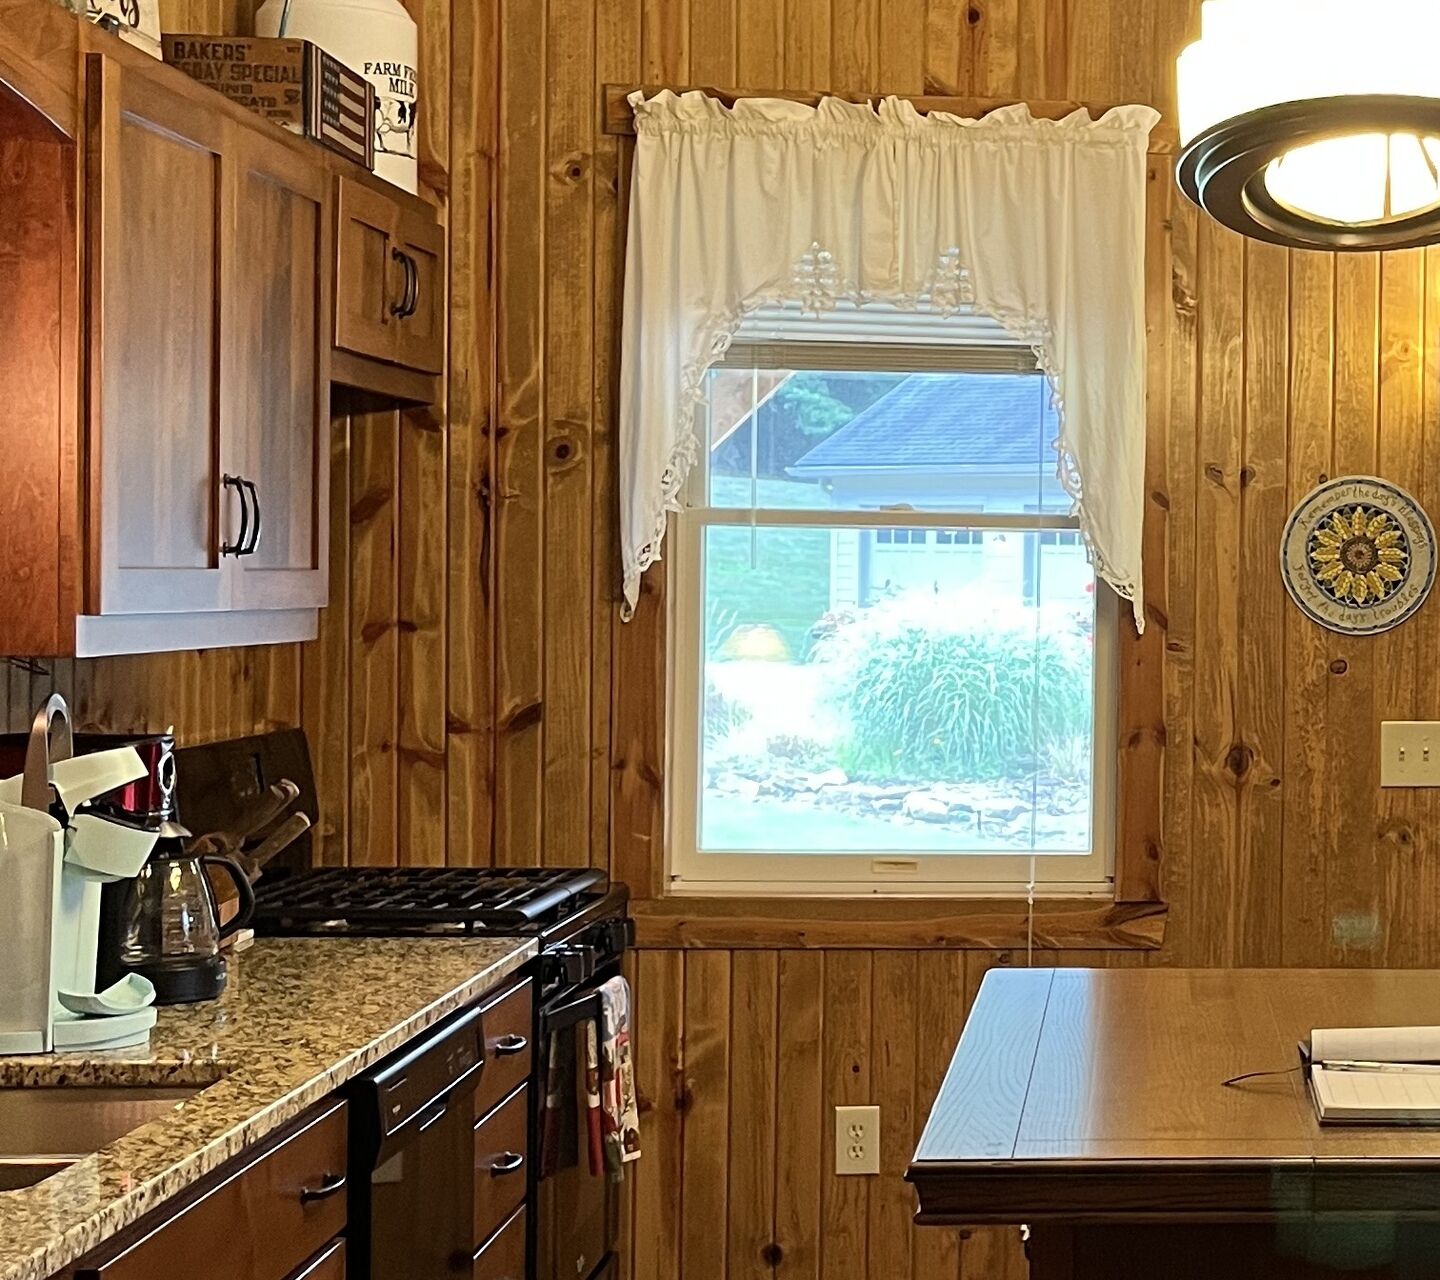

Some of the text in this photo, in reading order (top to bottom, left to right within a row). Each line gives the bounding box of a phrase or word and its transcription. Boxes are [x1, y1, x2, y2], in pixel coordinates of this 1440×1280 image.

[230, 63, 302, 84] SPECIAL
[363, 63, 401, 77] FARM
[1353, 485, 1370, 499] the
